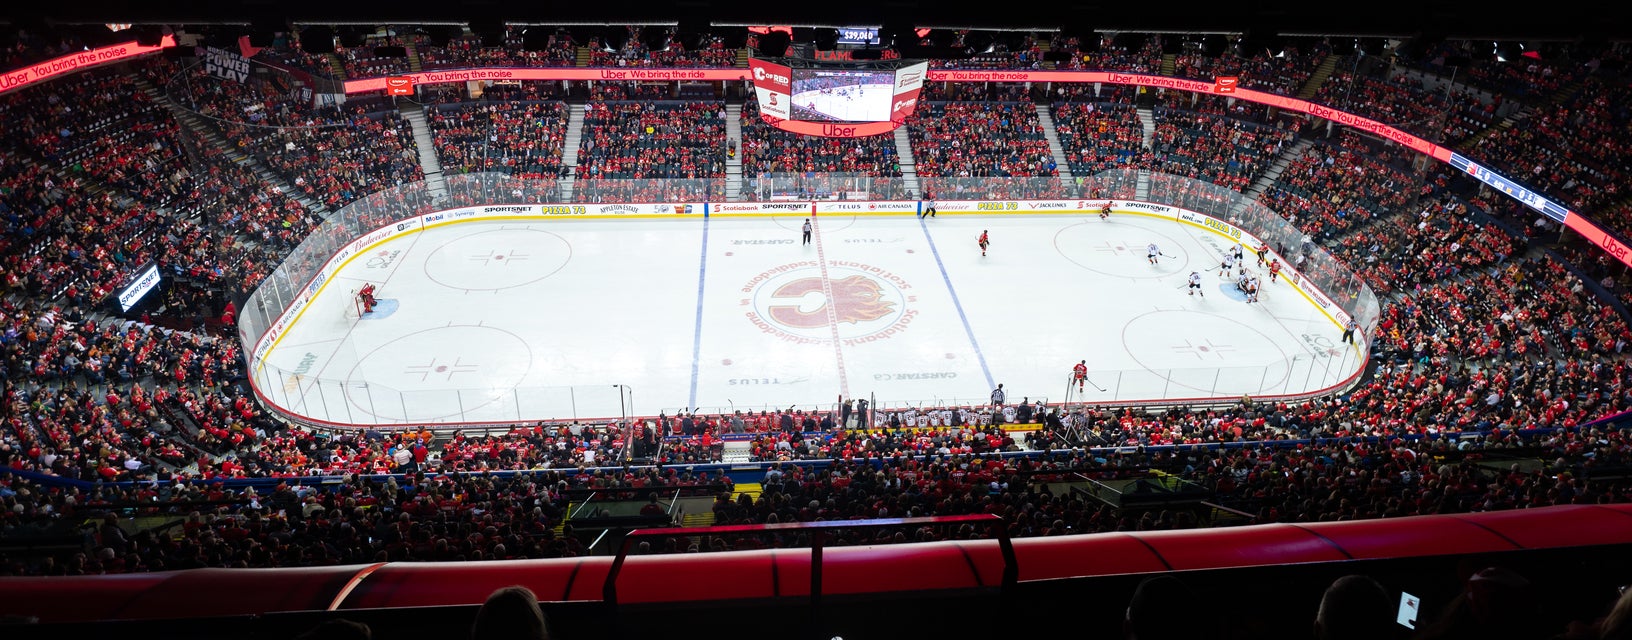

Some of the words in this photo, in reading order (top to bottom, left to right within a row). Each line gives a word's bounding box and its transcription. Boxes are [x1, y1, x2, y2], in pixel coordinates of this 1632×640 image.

[0, 73, 28, 88] Uber
[31, 65, 50, 78] You
[52, 57, 77, 72] bring
[79, 52, 96, 65] the
[98, 46, 126, 60] noise
[206, 53, 250, 73] POWER
[206, 63, 248, 84] PLAY
[424, 73, 439, 81] You
[442, 71, 469, 81] bring
[471, 70, 486, 78] the
[601, 70, 626, 78] Uber
[629, 70, 645, 78] We
[647, 70, 670, 80] bring
[672, 70, 688, 78] the
[951, 71, 967, 79] You
[969, 71, 990, 81] bring
[992, 71, 1005, 79] the
[1107, 73, 1132, 83] Uber
[1136, 75, 1151, 84] We
[1153, 77, 1175, 88] bring
[1177, 80, 1191, 88] the
[1192, 82, 1209, 90] ride
[822, 124, 857, 136] Uber
[1308, 103, 1333, 118] Uber
[1337, 110, 1353, 124] You
[1354, 119, 1378, 133] bring
[1379, 124, 1393, 137] the
[1392, 131, 1413, 145] noise
[542, 205, 571, 215] PIZZA
[572, 205, 587, 215] 73
[600, 205, 623, 213] APPLETON
[623, 204, 639, 213] ESTATE
[932, 202, 970, 211] udweiser
[977, 201, 1004, 211] PIZZA
[1005, 202, 1019, 211] 73
[1125, 202, 1170, 212] SPORTSNET
[425, 214, 444, 223] Mobil
[1204, 217, 1229, 233] PIZZA
[1230, 226, 1242, 239] 73
[353, 230, 393, 253] Budweiser
[1602, 234, 1628, 260] Uber
[333, 250, 349, 265] TELUS
[741, 260, 818, 293] Saddledome
[829, 260, 912, 291] Scotiabank
[121, 269, 157, 306] SPORTSNET
[745, 310, 832, 346] Saddledome
[843, 307, 919, 347] Scotiabank
[728, 377, 780, 386] TELUS
